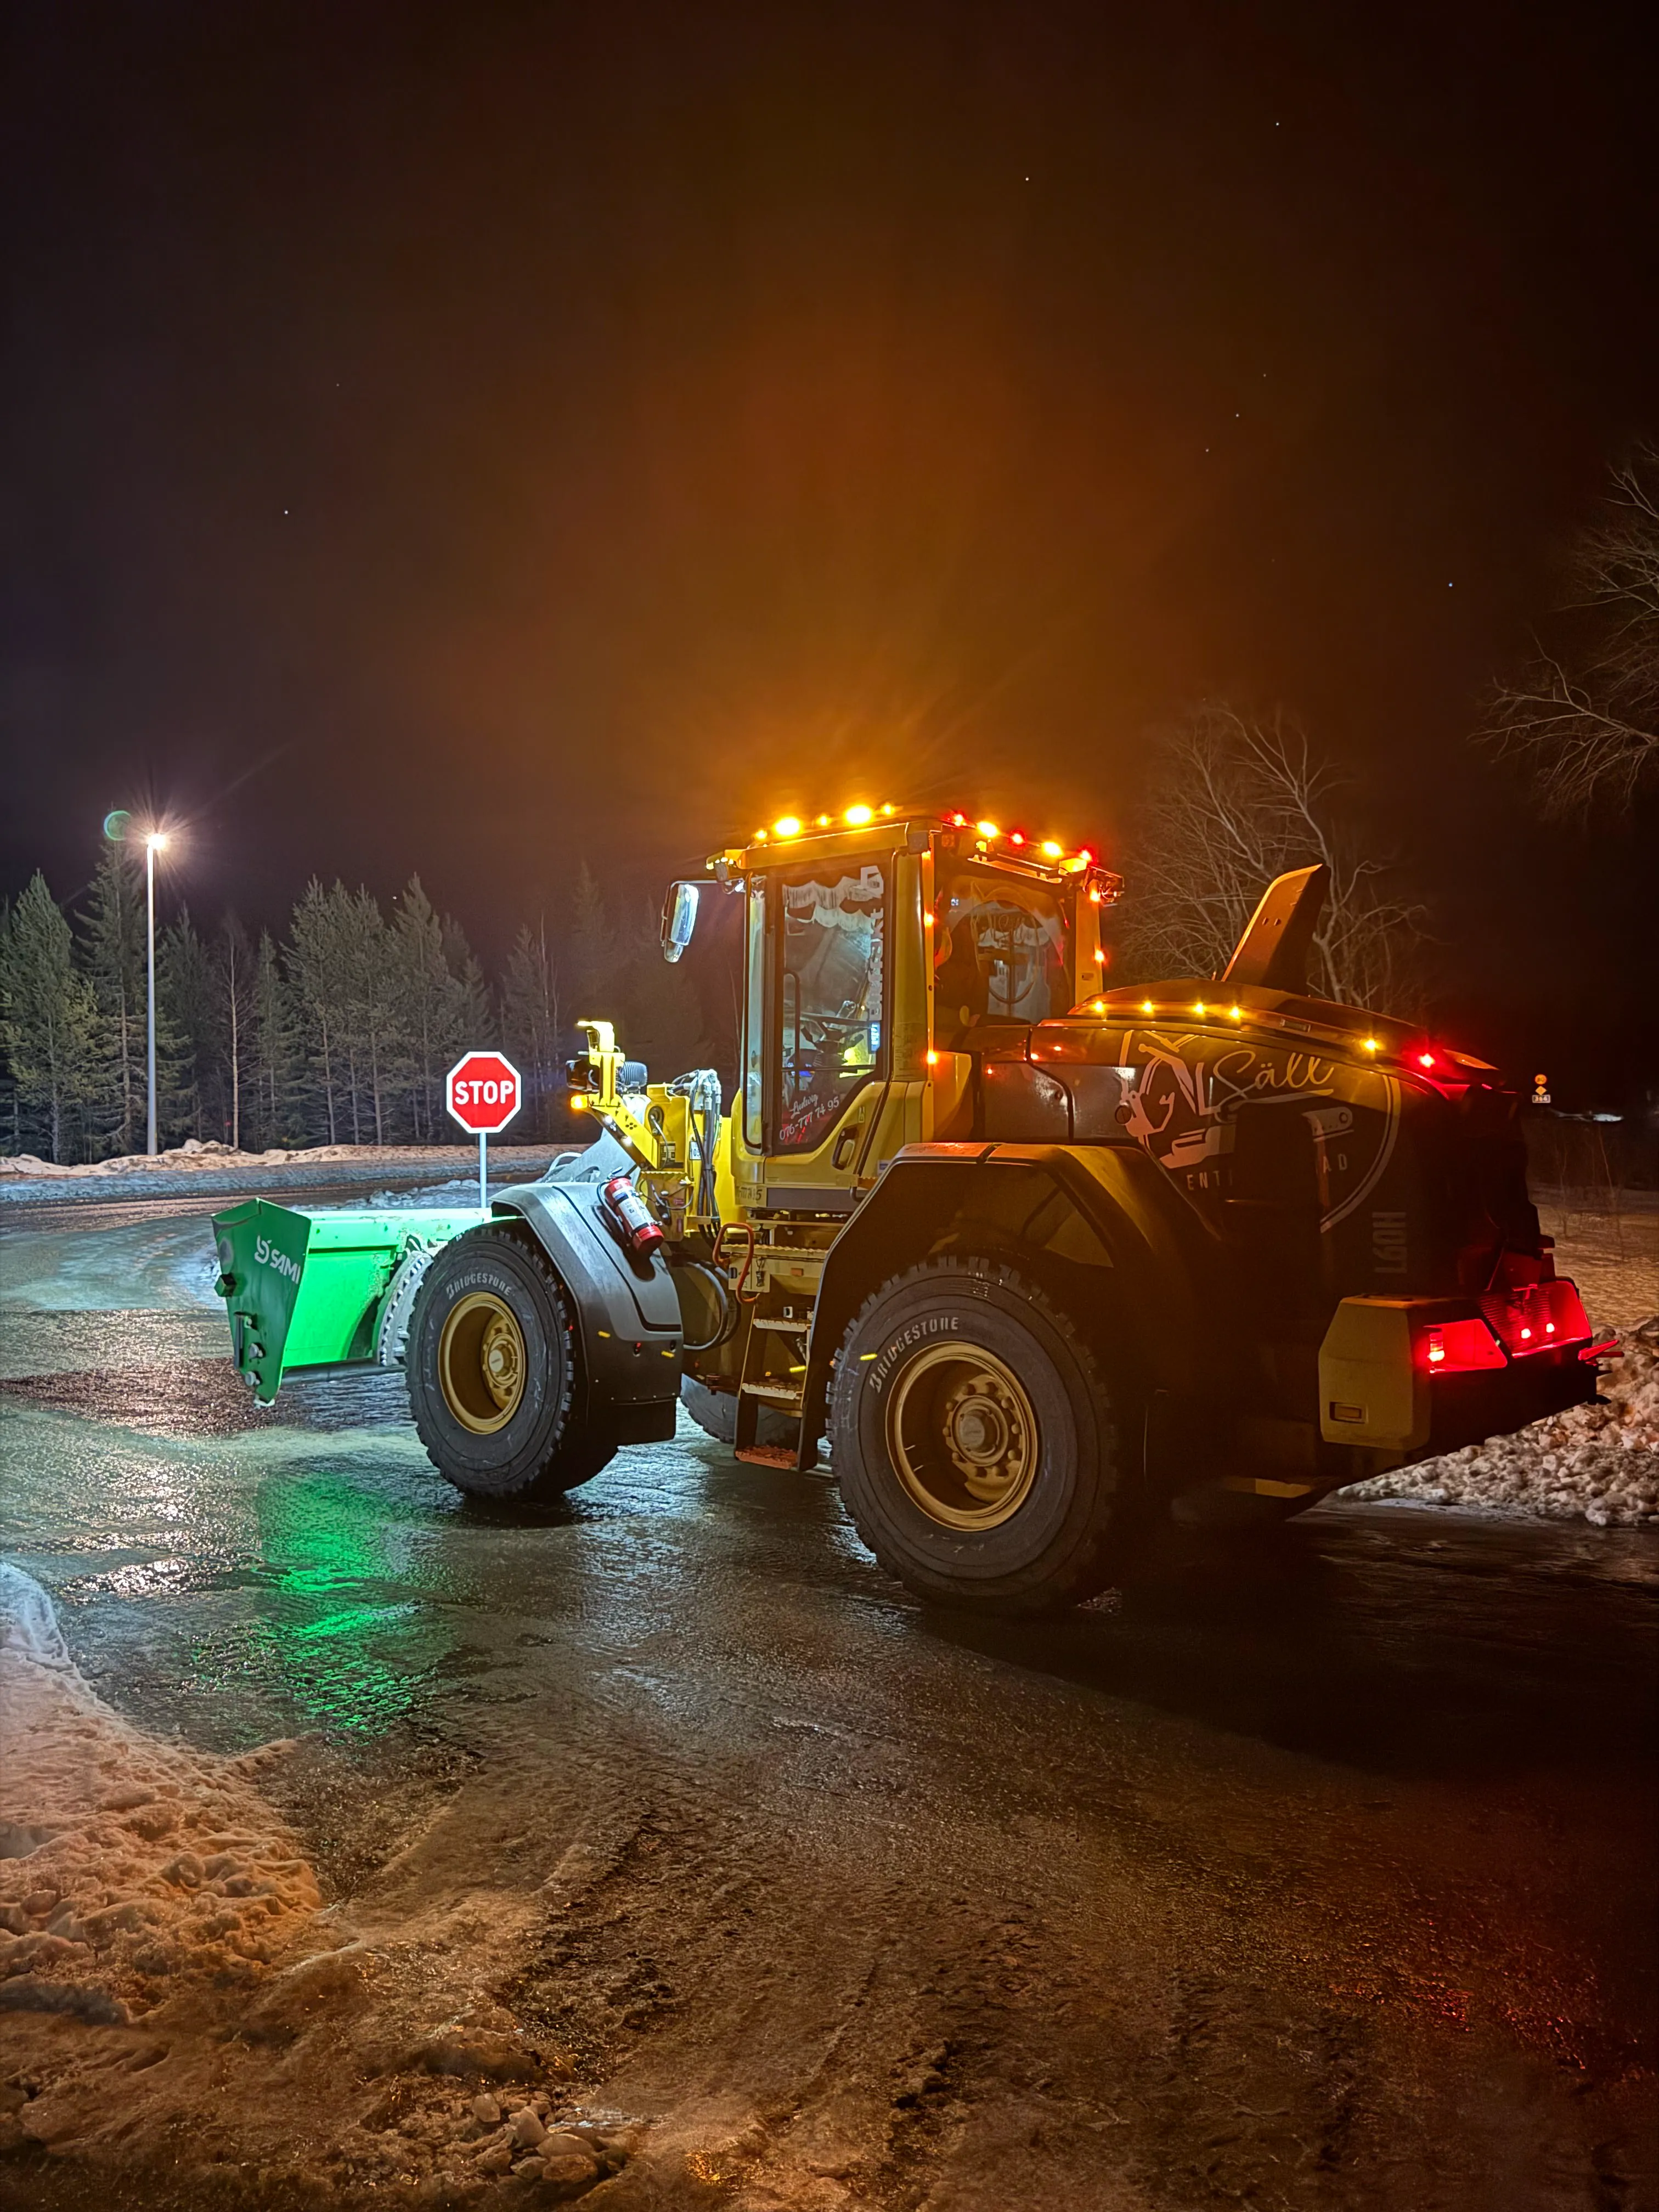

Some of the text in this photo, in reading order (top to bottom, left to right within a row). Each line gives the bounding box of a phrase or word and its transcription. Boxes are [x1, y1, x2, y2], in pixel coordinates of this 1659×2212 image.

[455, 1080, 514, 1105] STOP
[790, 1094, 818, 1119] Ludwig
[780, 1096, 839, 1140] 076-777 74 95
[269, 1249, 301, 1285] SAMI
[446, 1273, 512, 1300] BRIDGESTONE
[869, 1317, 959, 1393] BRIDGESTONE
